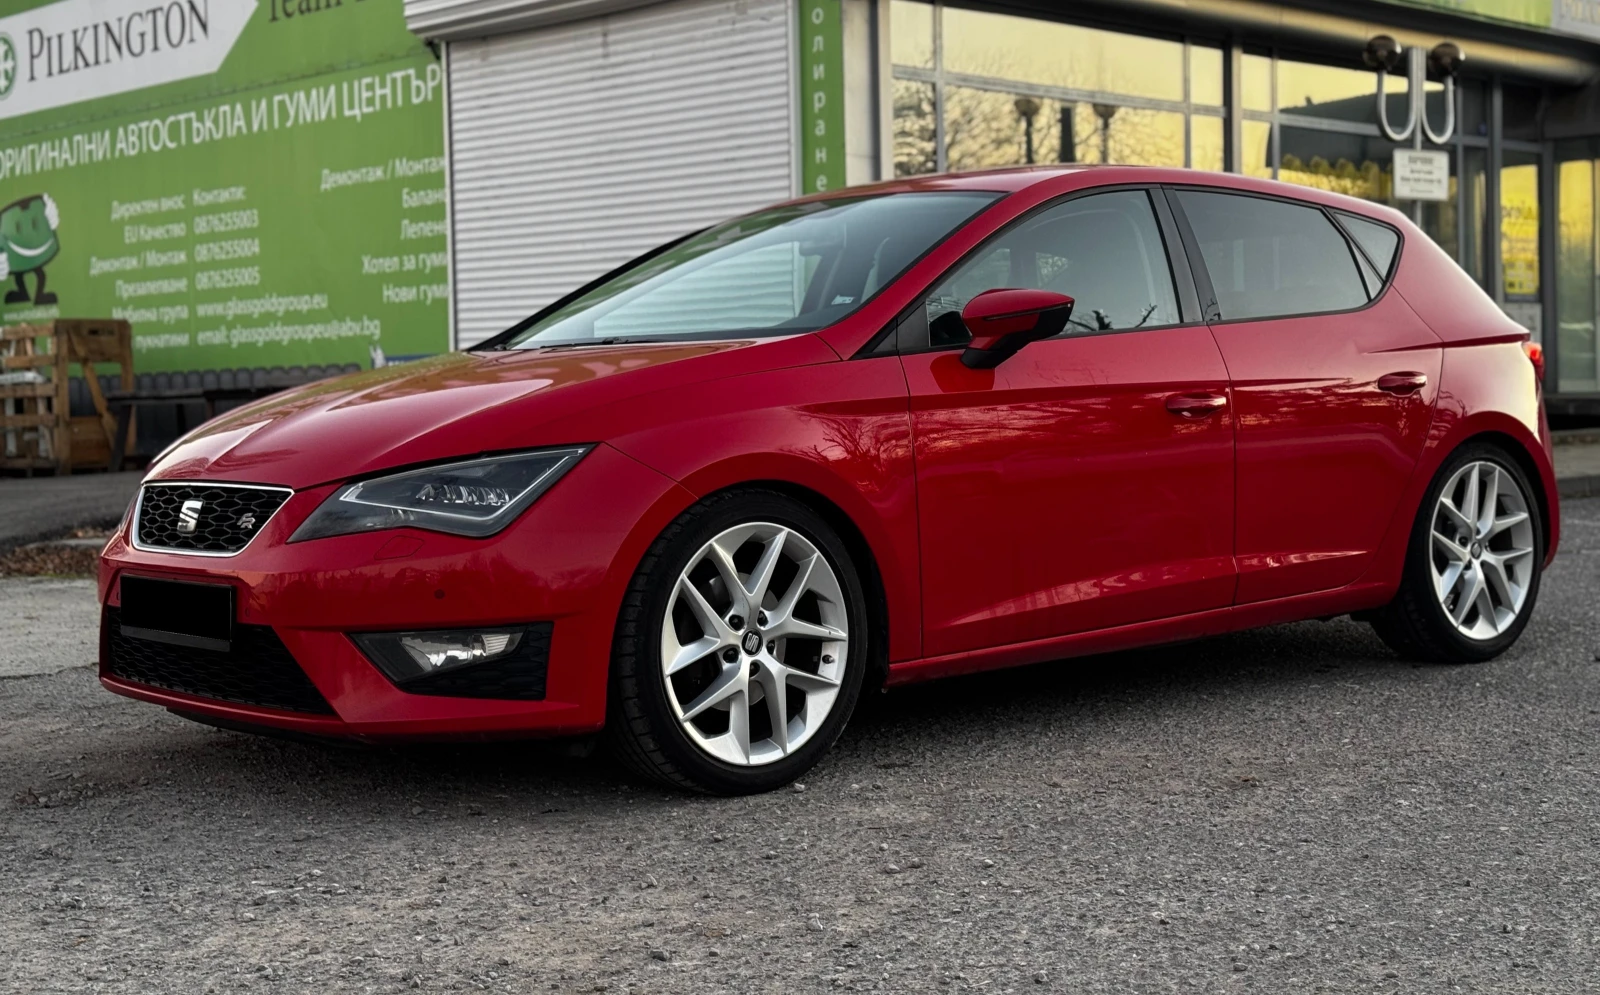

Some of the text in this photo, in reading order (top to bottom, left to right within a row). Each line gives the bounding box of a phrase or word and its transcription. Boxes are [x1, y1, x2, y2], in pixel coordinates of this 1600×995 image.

[27, 0, 208, 82] PILKINGTON
[115, 103, 247, 158] АВТОСТЪКЛА
[251, 97, 268, 133] И
[273, 84, 336, 129] ГУМИ
[342, 64, 441, 122] ЦЕНТЪР
[320, 166, 384, 192] Демонтаж
[362, 255, 399, 274] Хотел
[402, 254, 416, 271] за
[382, 284, 417, 304] Нови
